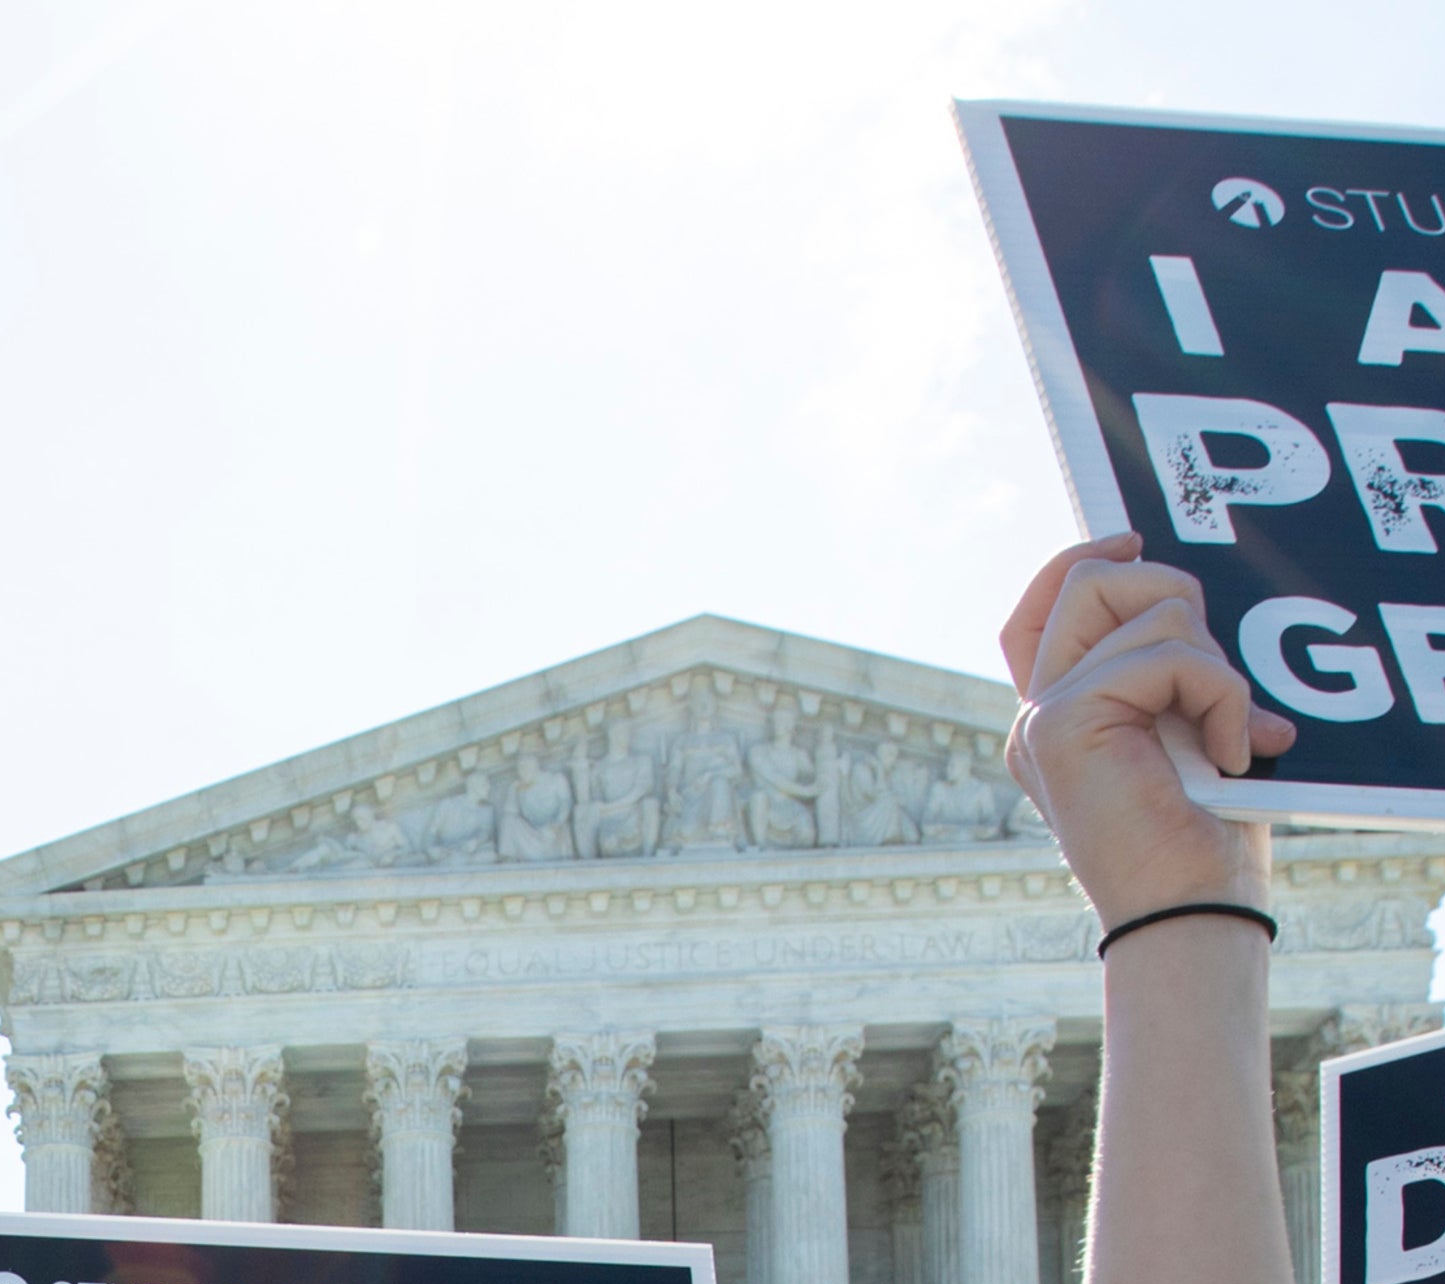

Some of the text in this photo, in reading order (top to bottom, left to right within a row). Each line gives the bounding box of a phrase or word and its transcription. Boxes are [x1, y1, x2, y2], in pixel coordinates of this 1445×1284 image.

[1148, 255, 1224, 356] I
[442, 930, 975, 977] EQUAL JUSTICE UNDER LAW
